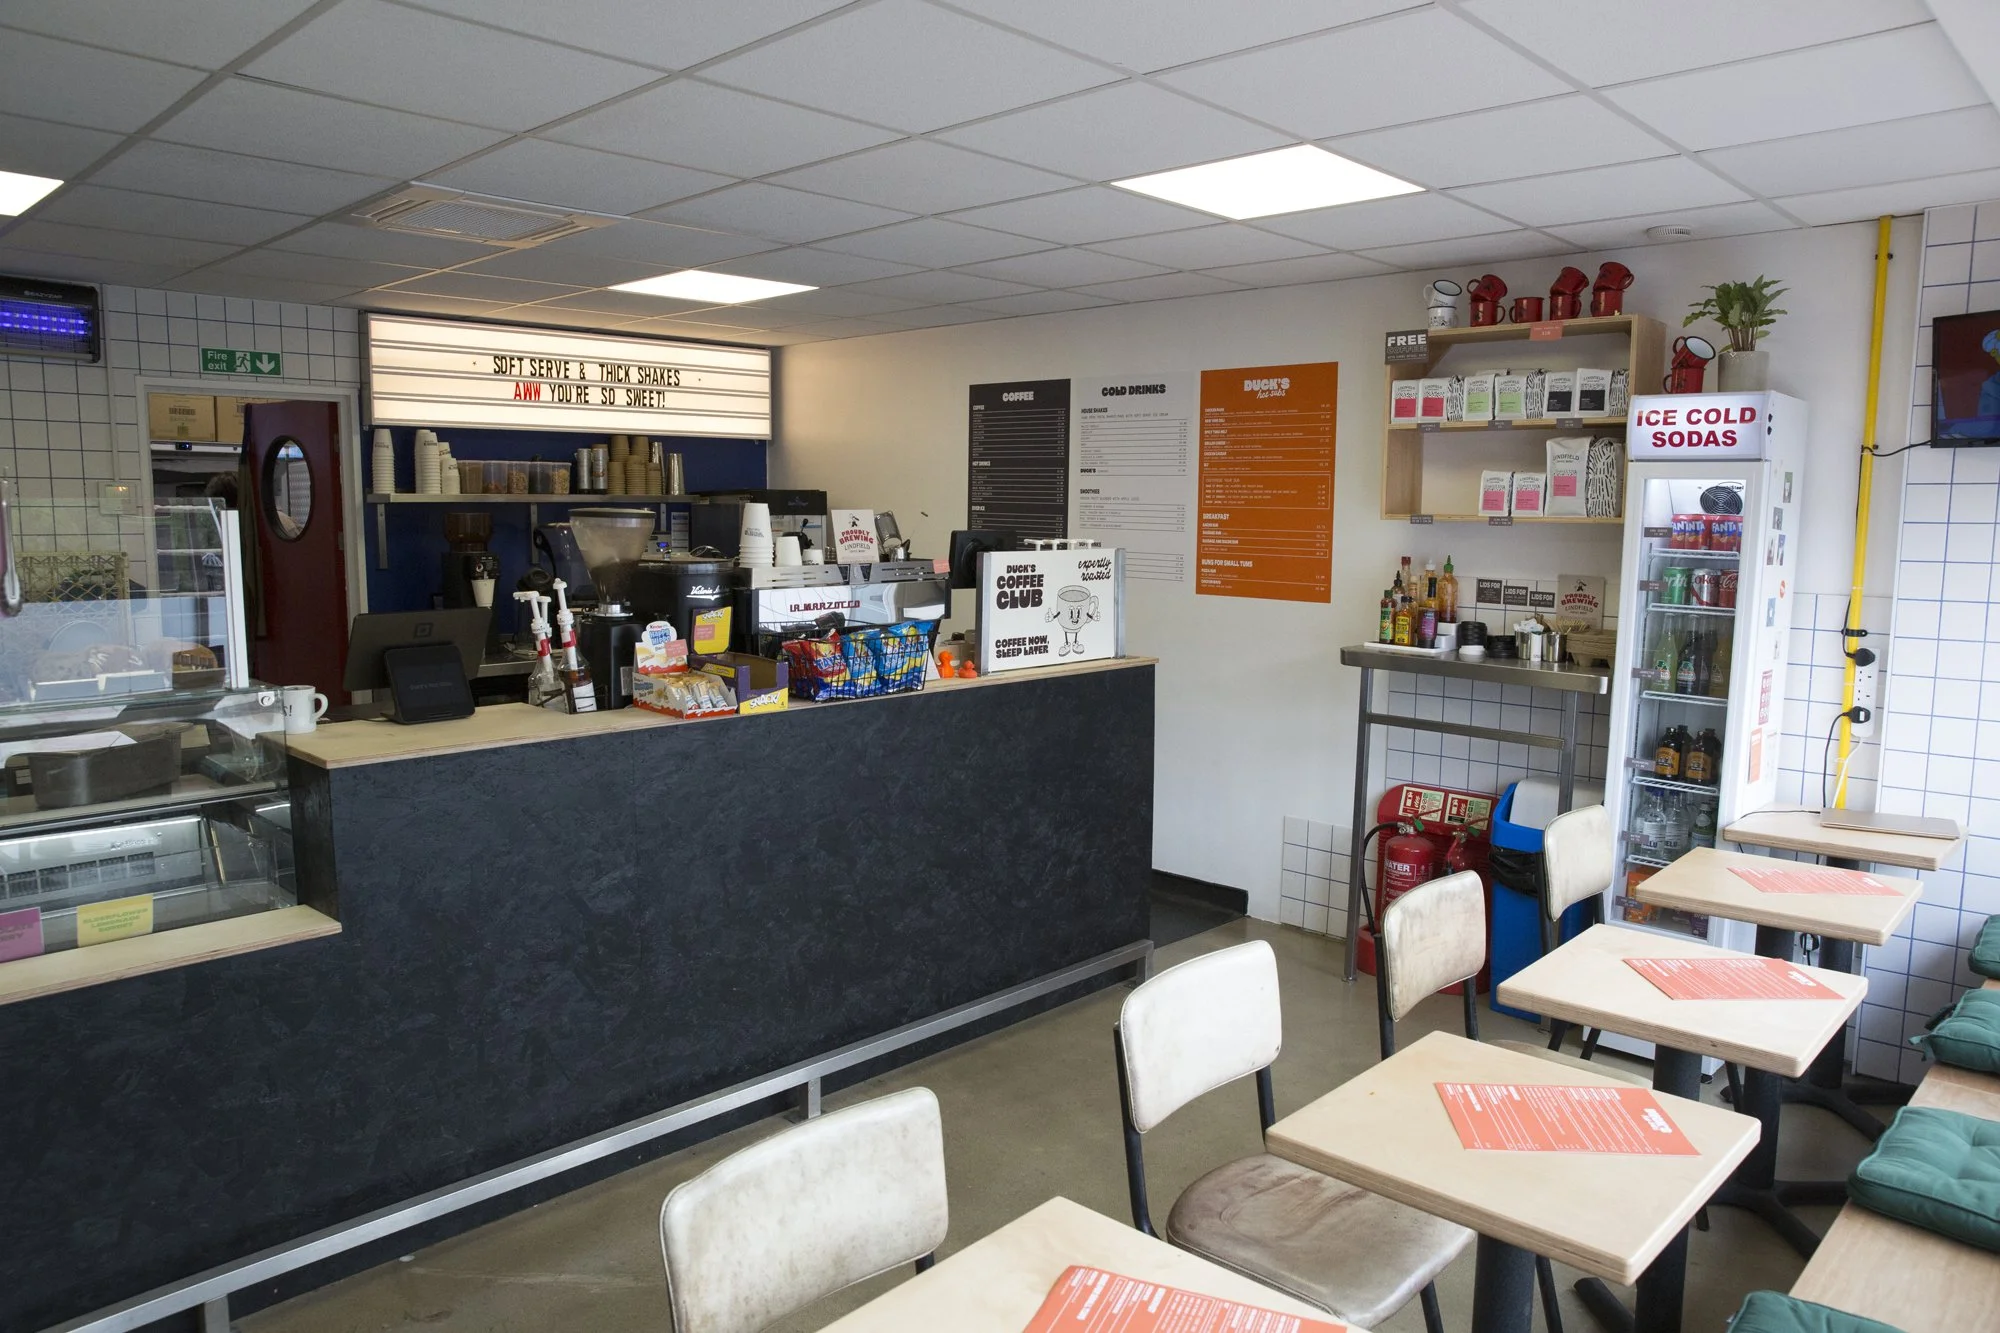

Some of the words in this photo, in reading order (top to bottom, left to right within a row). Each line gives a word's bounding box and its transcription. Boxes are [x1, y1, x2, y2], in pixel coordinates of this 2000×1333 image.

[1387, 334, 1427, 346] FREE
[207, 350, 228, 360] Fire
[207, 361, 227, 371] exit
[493, 356, 524, 376] SOFT
[530, 358, 570, 379] SERVE
[579, 362, 586, 380] &
[599, 364, 631, 383] THICK
[638, 367, 681, 387] SHAKES
[1101, 386, 1127, 397] COLD
[1128, 384, 1166, 396] DRINKS
[1243, 377, 1290, 391] DUCK'S
[514, 382, 541, 401] AWW
[549, 384, 589, 404] YOU'RE
[601, 387, 616, 405] SO
[626, 390, 666, 408] SWEET!
[1002, 391, 1035, 402] COFFEE
[1636, 409, 1677, 427] ICE
[1686, 406, 1757, 425] COLD
[1652, 430, 1737, 448] SODAS
[838, 534, 875, 545] BREWING
[841, 529, 871, 537] PROUDLY
[844, 543, 871, 551] LINDFIELD
[1006, 564, 1037, 574] DUCK'S
[1077, 556, 1112, 572] expertly
[1081, 569, 1111, 581] roasted
[996, 574, 1045, 590] COFFEE
[996, 588, 1044, 610] CLUB
[1561, 597, 1599, 608] BREWING
[1564, 593, 1596, 601] PROUDLY
[790, 604, 800, 612] LA
[803, 600, 860, 611] MARZOCCO
[995, 636, 1027, 649] COFFEE
[1028, 635, 1050, 646] NOW,
[995, 647, 1023, 659] SLEEP
[1023, 645, 1049, 656] LATER
[749, 690, 781, 709] SNACK!
[1384, 859, 1410, 872] WATER
